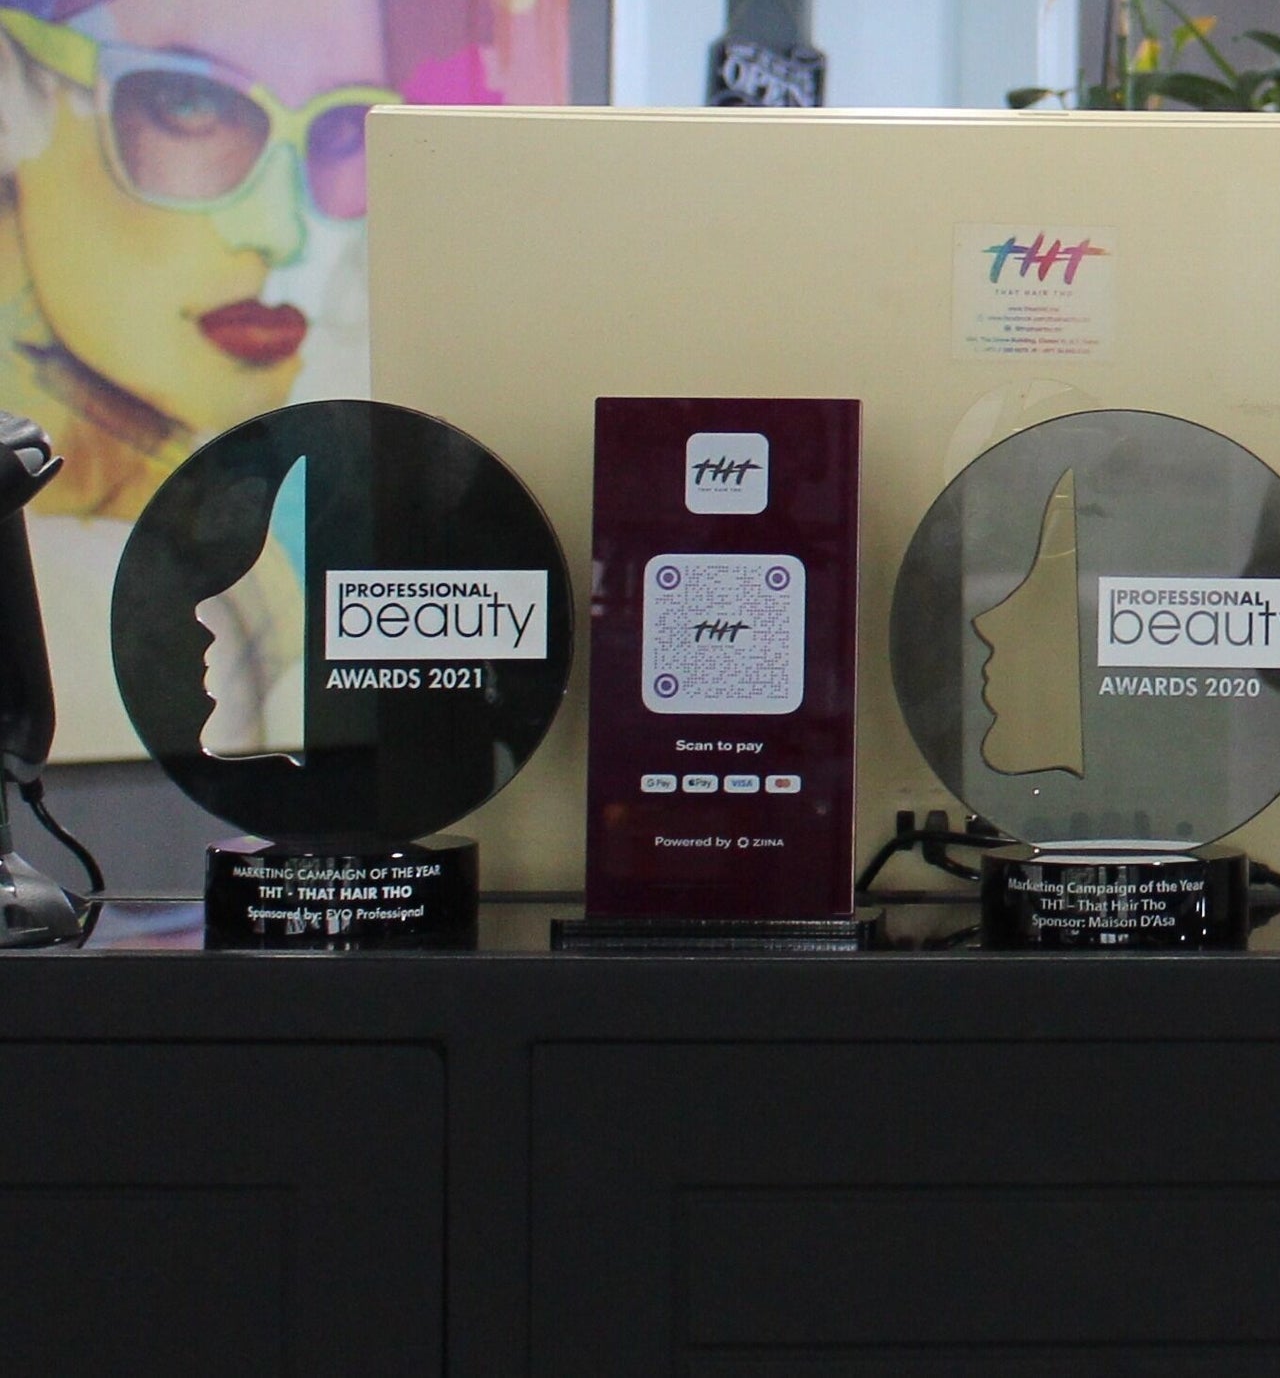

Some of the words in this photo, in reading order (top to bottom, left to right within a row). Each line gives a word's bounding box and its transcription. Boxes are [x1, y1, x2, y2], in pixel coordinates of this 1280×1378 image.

[980, 231, 1112, 285] THT
[345, 583, 492, 598] PROFESSIONAL
[1116, 589, 1264, 606] PROFESSIONAL
[338, 582, 536, 649] beauty
[326, 668, 422, 689] AWARDS
[428, 668, 483, 689] 2021
[1098, 676, 1198, 697] AWARDS
[1205, 678, 1261, 698] 2020
[676, 740, 713, 752] Scan
[717, 740, 733, 752] to
[736, 742, 764, 754] pay
[731, 779, 753, 788] VISA
[654, 836, 712, 847] Powered
[715, 837, 732, 849] by
[752, 839, 785, 847] ZIINA
[232, 866, 294, 881] MARKETING
[297, 869, 367, 881] CAMPAIGN
[370, 868, 389, 880] OF
[392, 867, 414, 879] THE
[415, 864, 442, 878] YEAR
[259, 886, 284, 899] THT
[298, 887, 336, 900] THAT
[340, 886, 378, 901] HAIR
[382, 885, 413, 899] THO
[1008, 878, 1065, 895] Marketing
[1067, 881, 1137, 897] Campaign
[1139, 880, 1155, 893] of
[1155, 880, 1178, 893] the
[1179, 879, 1205, 892] Year
[247, 906, 300, 920] Sponsored
[304, 907, 323, 922] by:
[326, 908, 353, 921] EVO
[356, 904, 425, 920] Professional
[1040, 898, 1065, 910] THT
[1078, 898, 1108, 912] That
[1111, 899, 1139, 912] Hair
[1143, 898, 1167, 911] Tho
[1031, 914, 1086, 929] Sponsor:
[1088, 915, 1137, 928] Maison
